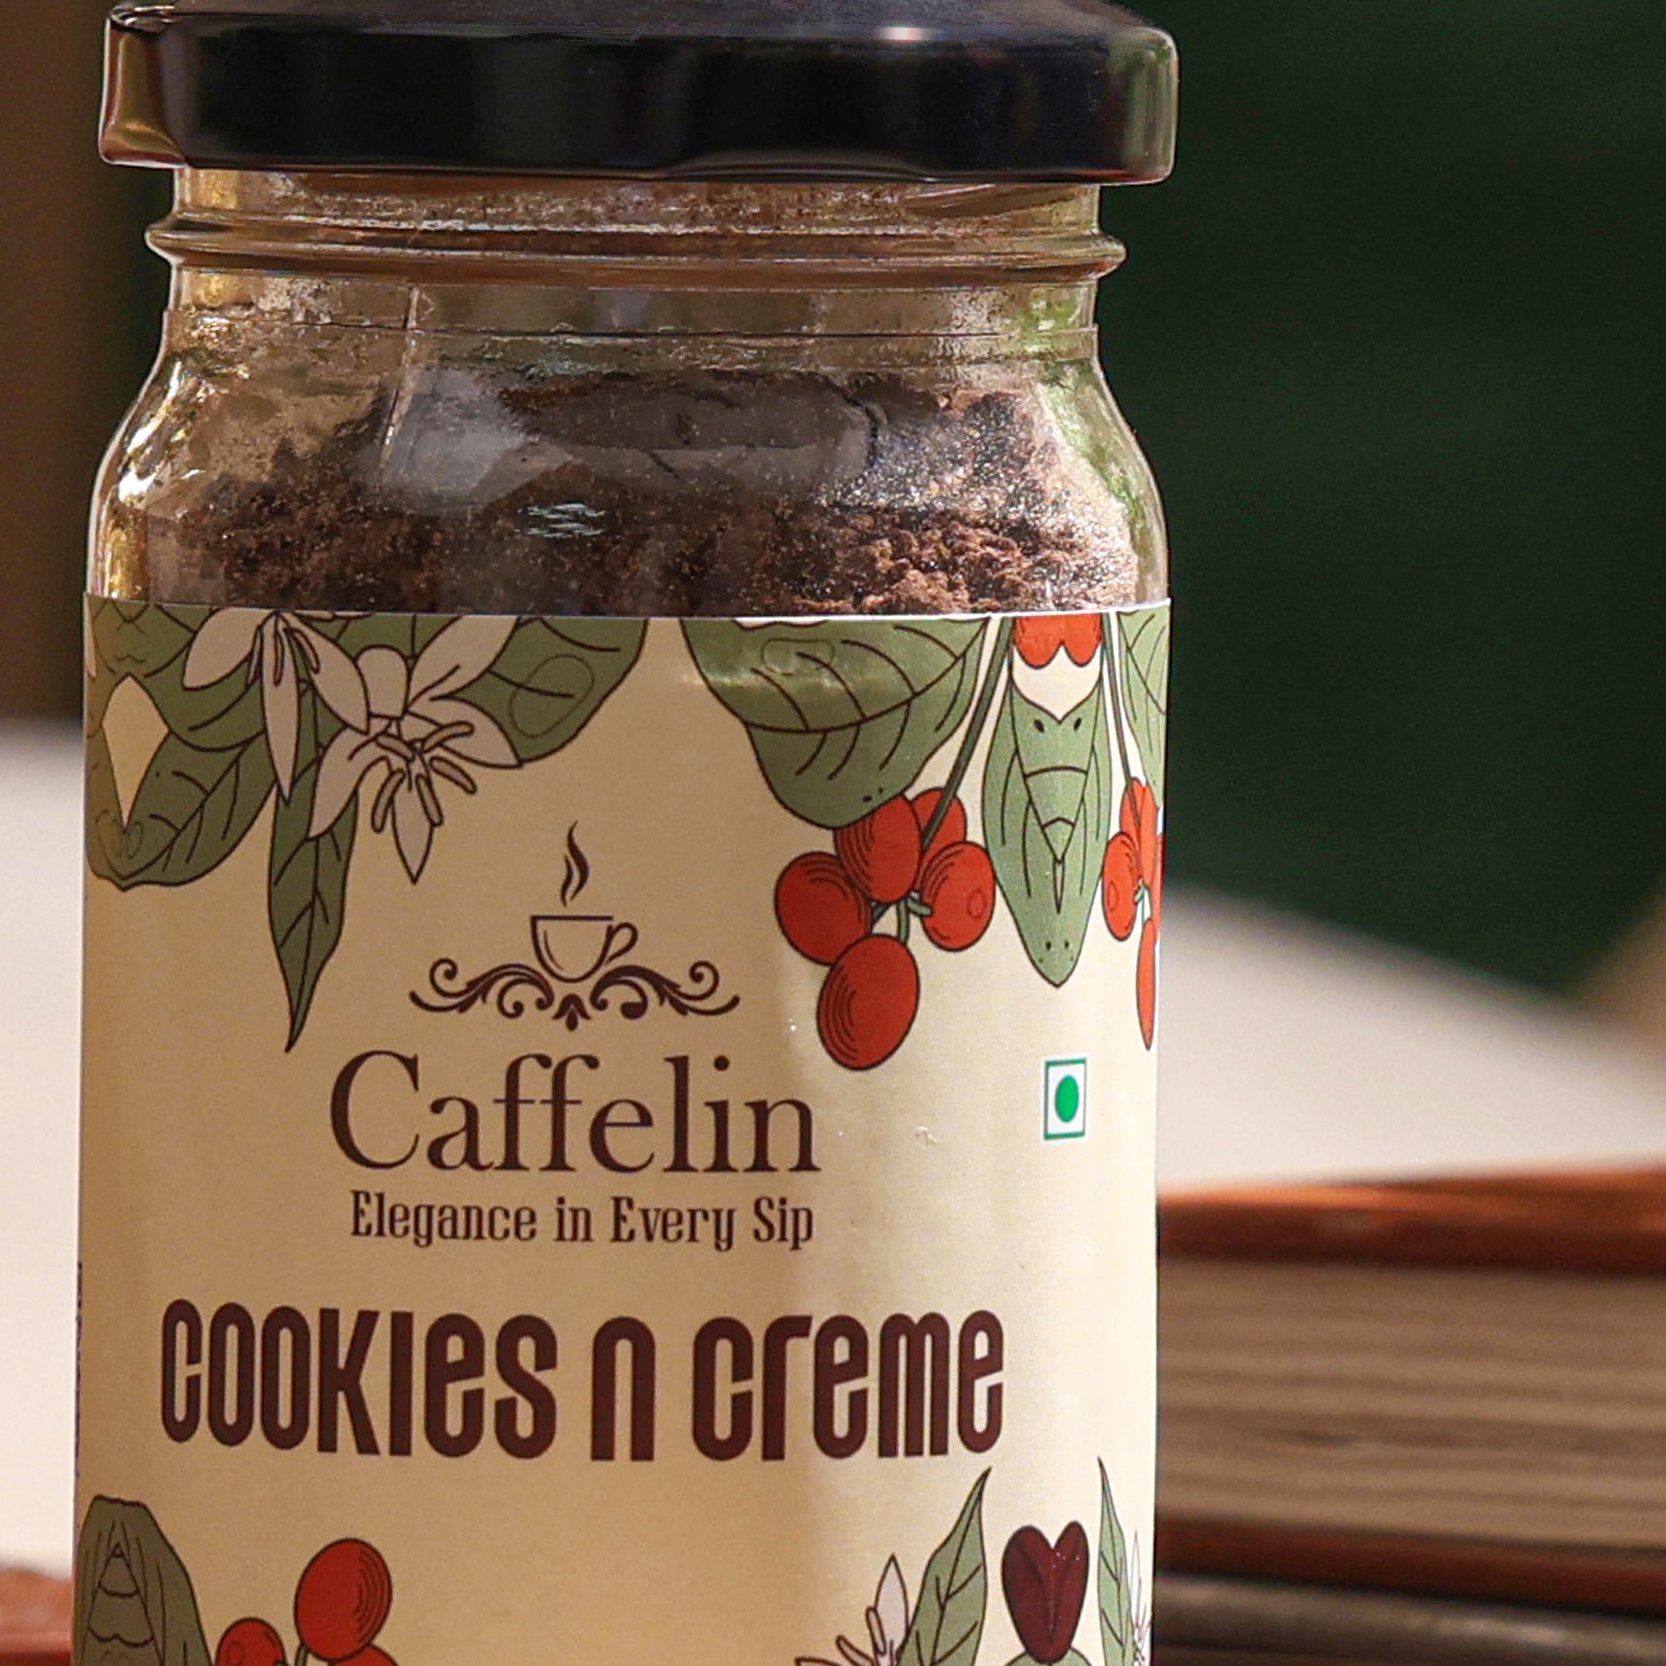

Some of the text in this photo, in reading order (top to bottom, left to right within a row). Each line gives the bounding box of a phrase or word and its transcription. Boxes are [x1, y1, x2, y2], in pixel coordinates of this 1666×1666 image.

[329, 1050, 821, 1174] Caffelin
[349, 1189, 815, 1252] Elegance in Every Sip
